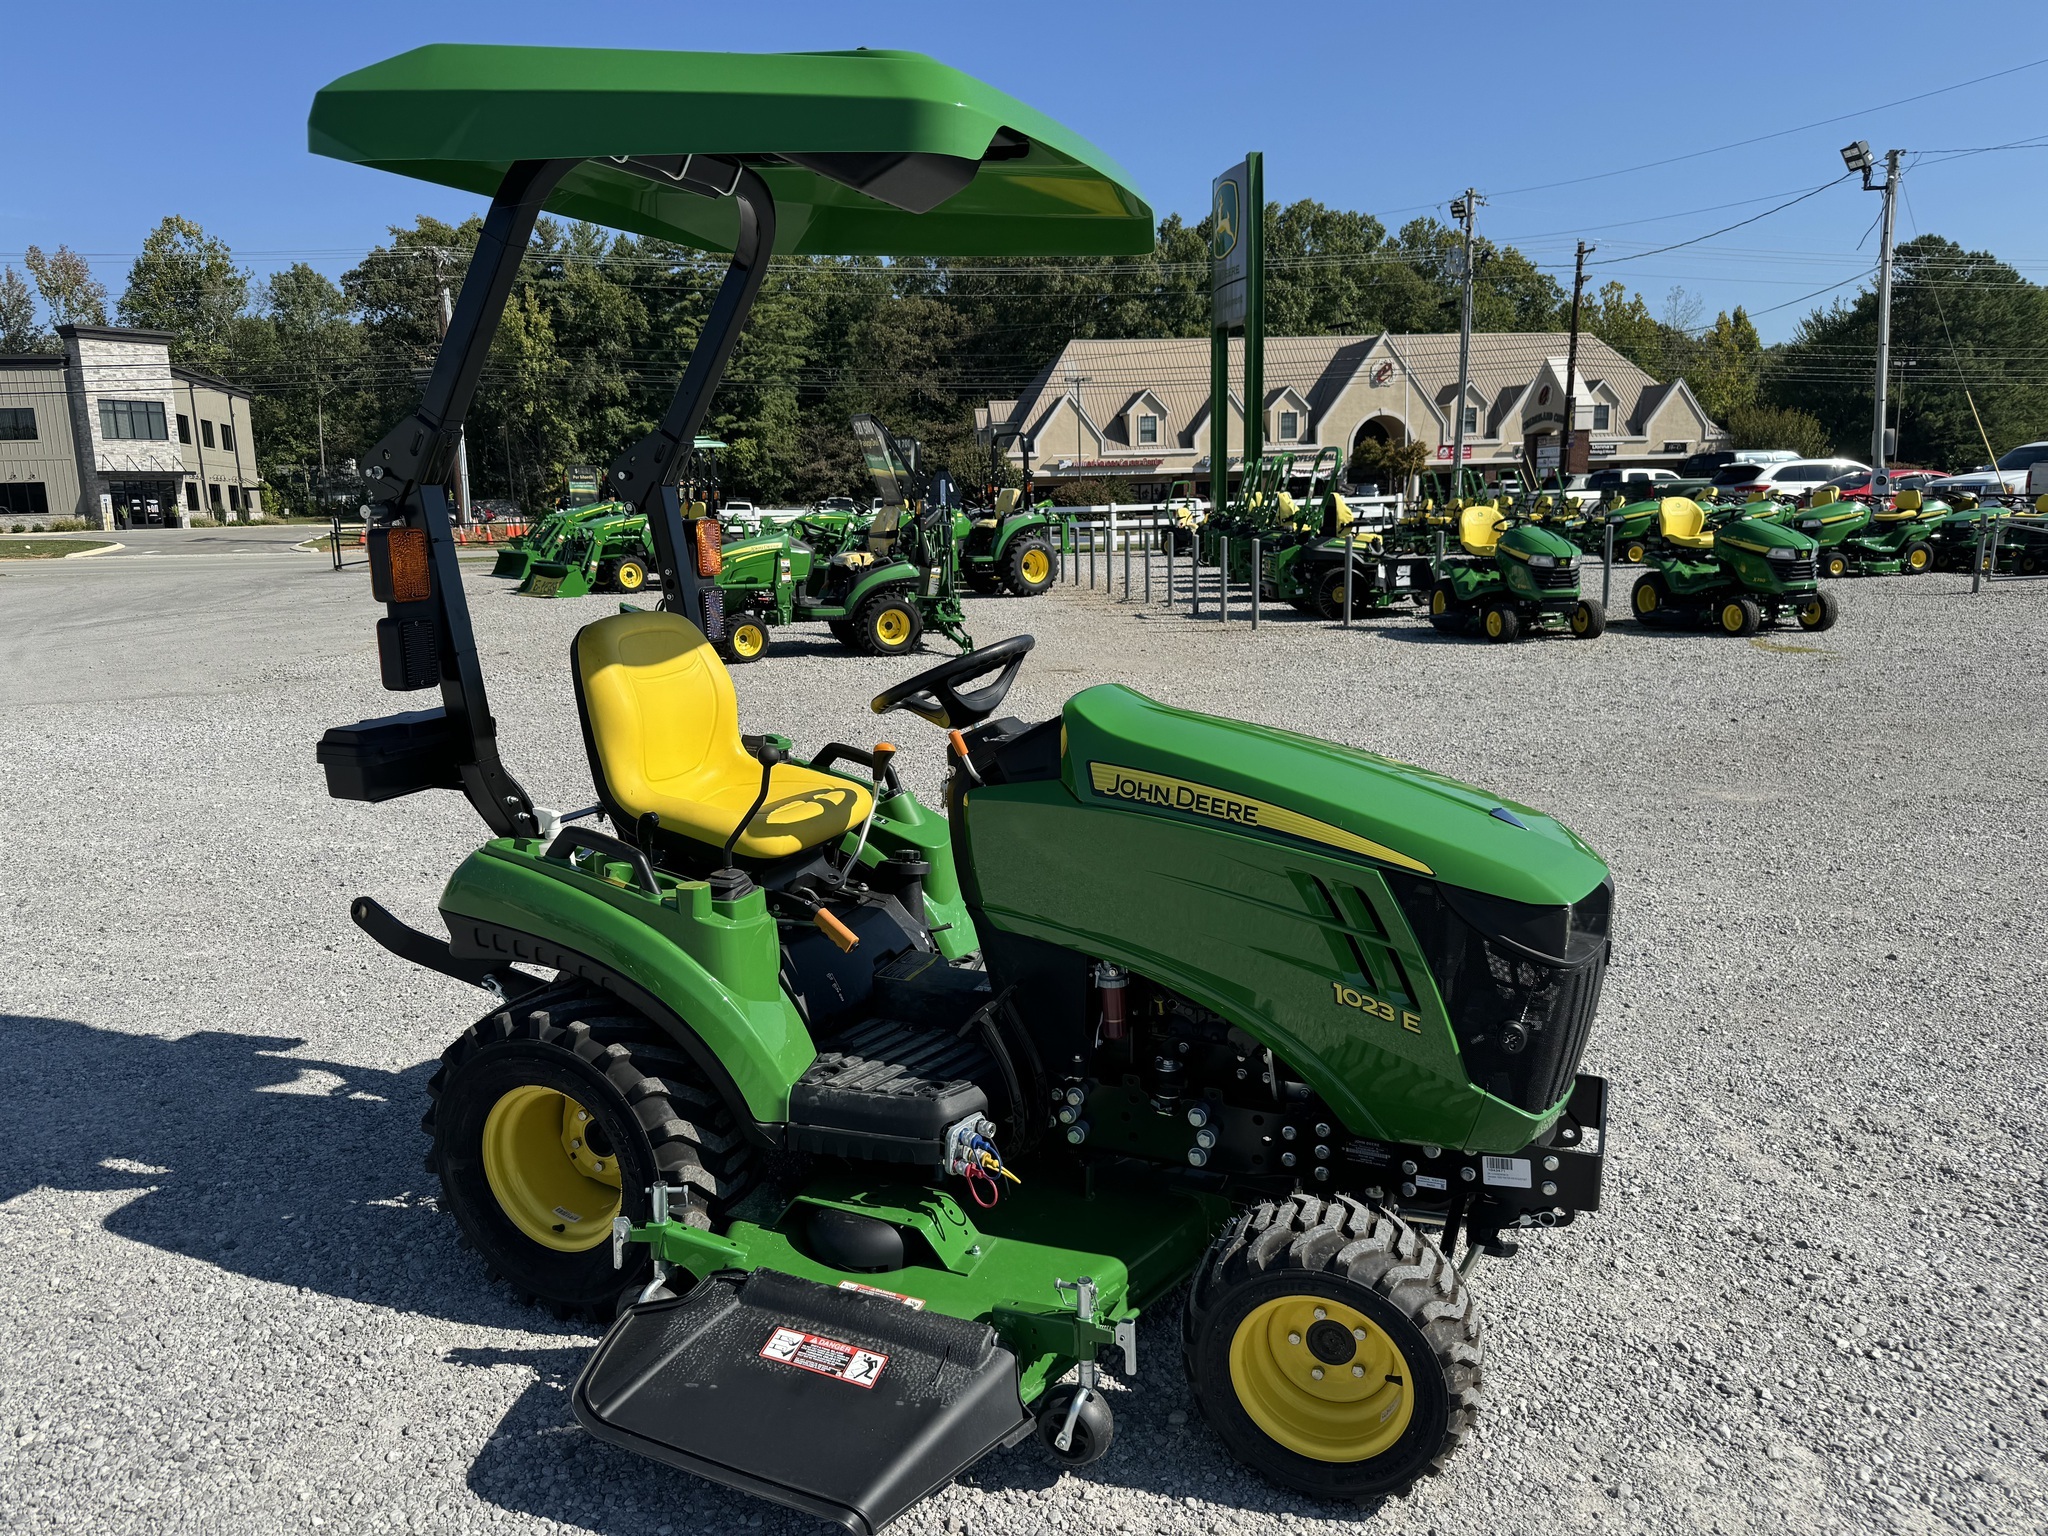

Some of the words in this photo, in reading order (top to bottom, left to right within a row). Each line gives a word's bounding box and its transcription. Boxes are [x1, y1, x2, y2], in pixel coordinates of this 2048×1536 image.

[1106, 773, 1170, 804] JOHN
[1176, 786, 1259, 825] DEERE
[1331, 981, 1396, 1022] 1023
[1402, 1010, 1422, 1035] E
[819, 1339, 851, 1353] DANGER
